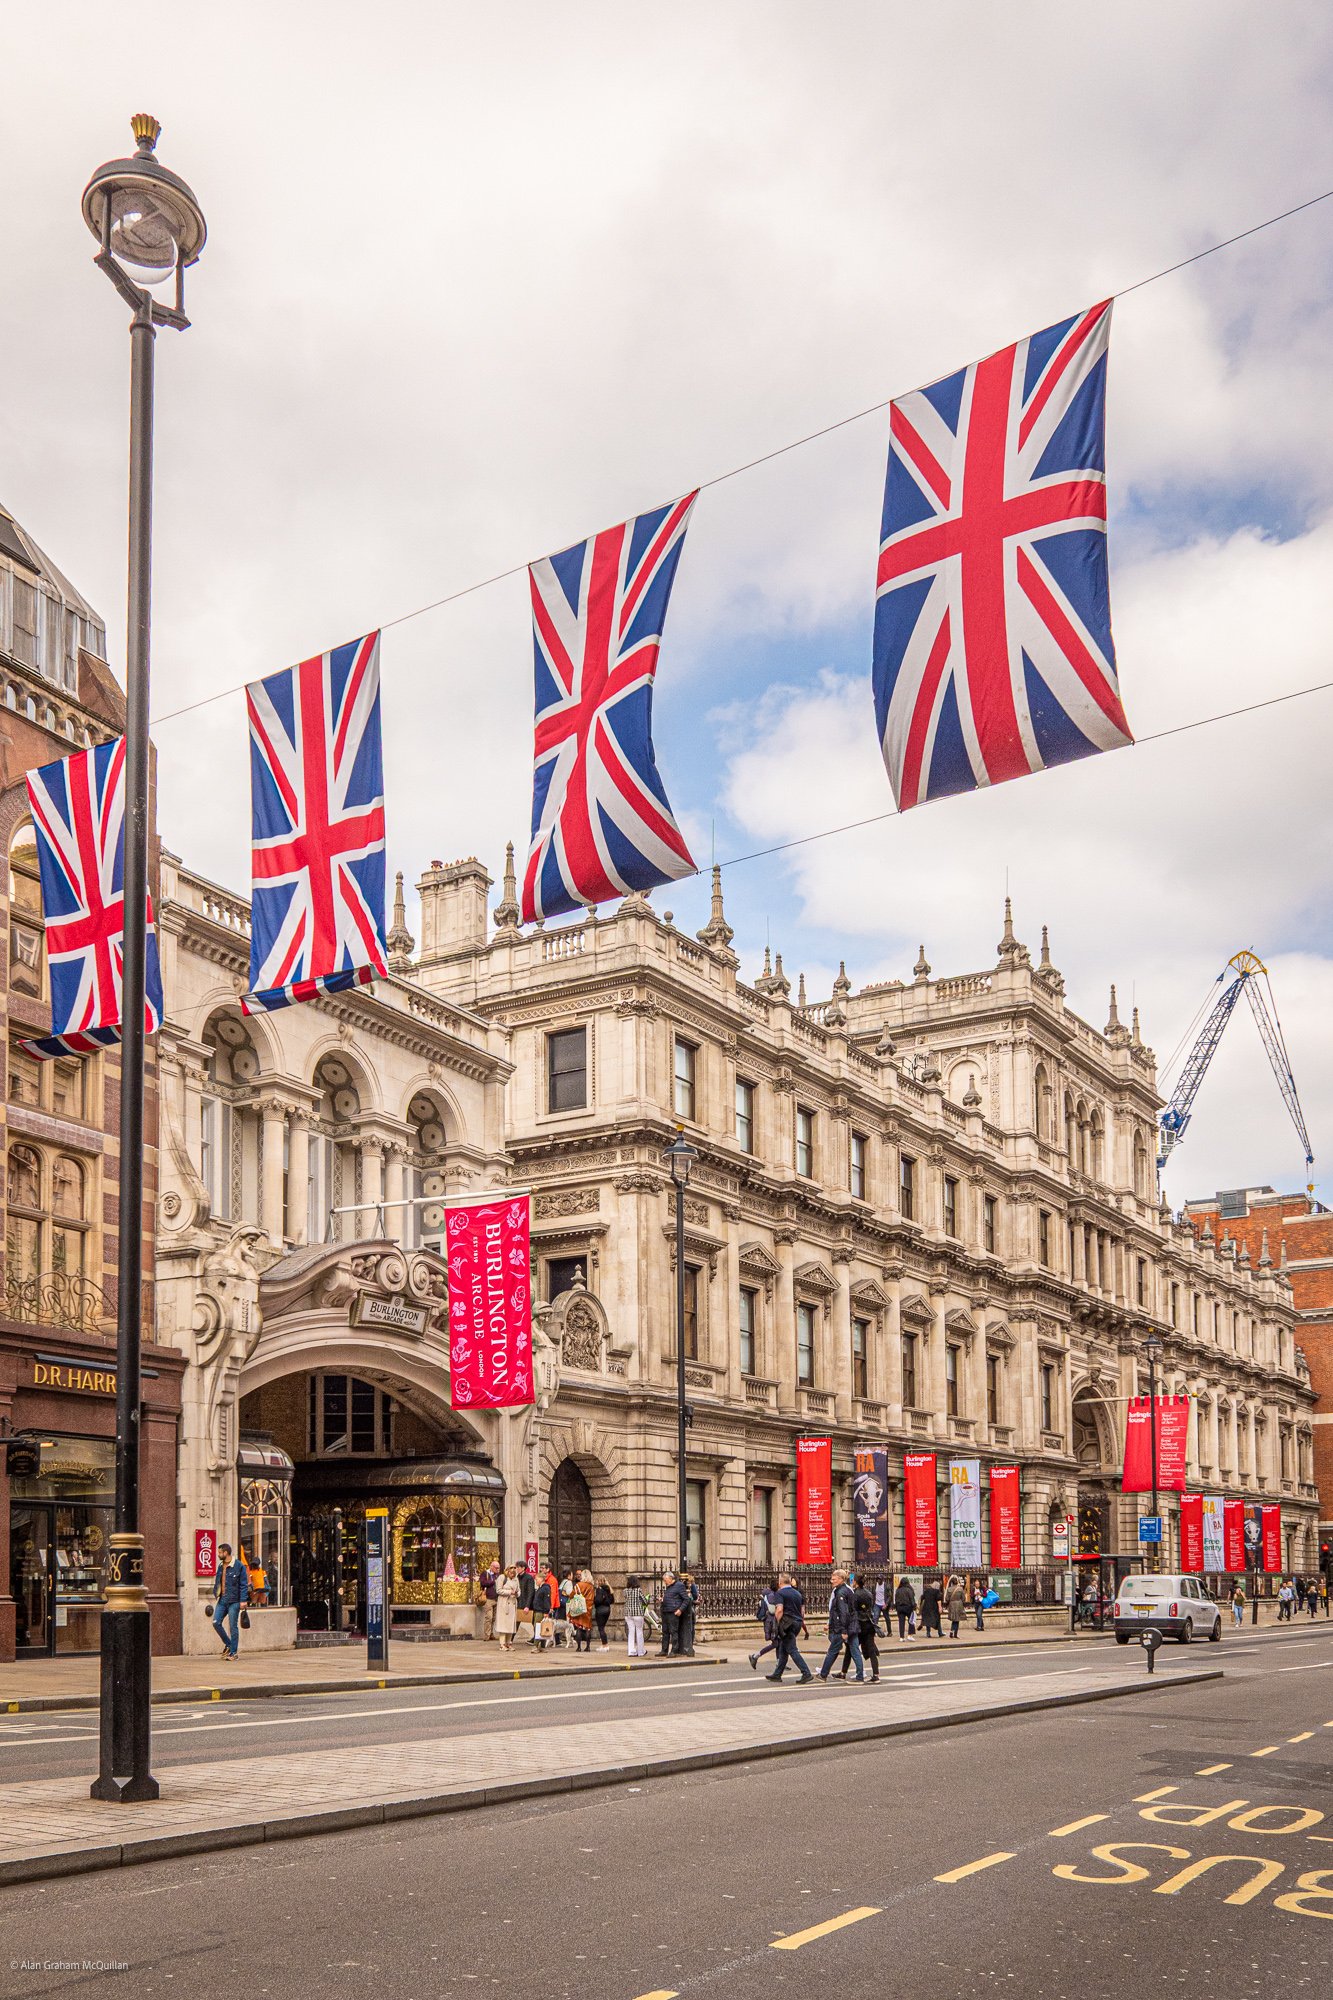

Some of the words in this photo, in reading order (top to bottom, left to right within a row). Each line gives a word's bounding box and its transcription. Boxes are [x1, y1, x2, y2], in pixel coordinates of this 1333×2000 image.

[370, 1301, 420, 1321] BURLINGTON
[471, 1273, 485, 1339] ARCADE
[485, 1222, 509, 1386] BURLINGTON
[382, 1315, 404, 1324] ARCADE
[799, 1440, 827, 1448] Burlington
[856, 1454, 874, 1472] RA
[952, 1466, 968, 1484] RA
[1203, 1501, 1216, 1514] RA
[953, 1520, 975, 1528] Free
[953, 1529, 978, 1539] entry
